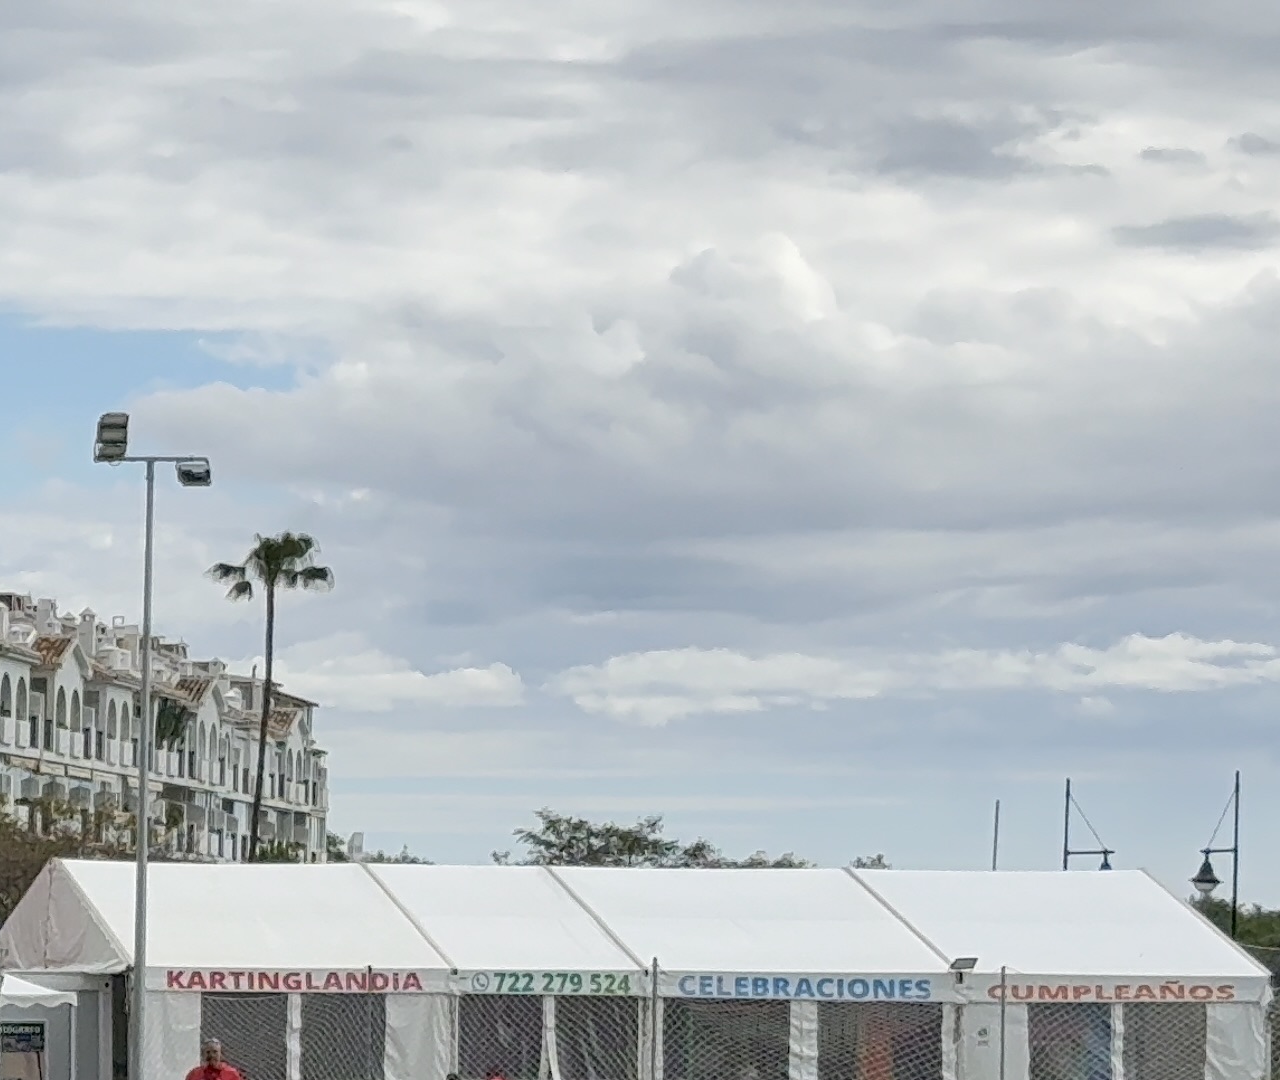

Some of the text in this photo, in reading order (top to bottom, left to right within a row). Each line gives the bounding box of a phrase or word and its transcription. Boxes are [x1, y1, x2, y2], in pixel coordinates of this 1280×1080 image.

[493, 972, 631, 994] 722 279 524
[678, 975, 932, 999] CELEBRACIONES
[987, 980, 1235, 1000] CUMPLEAÑOS
